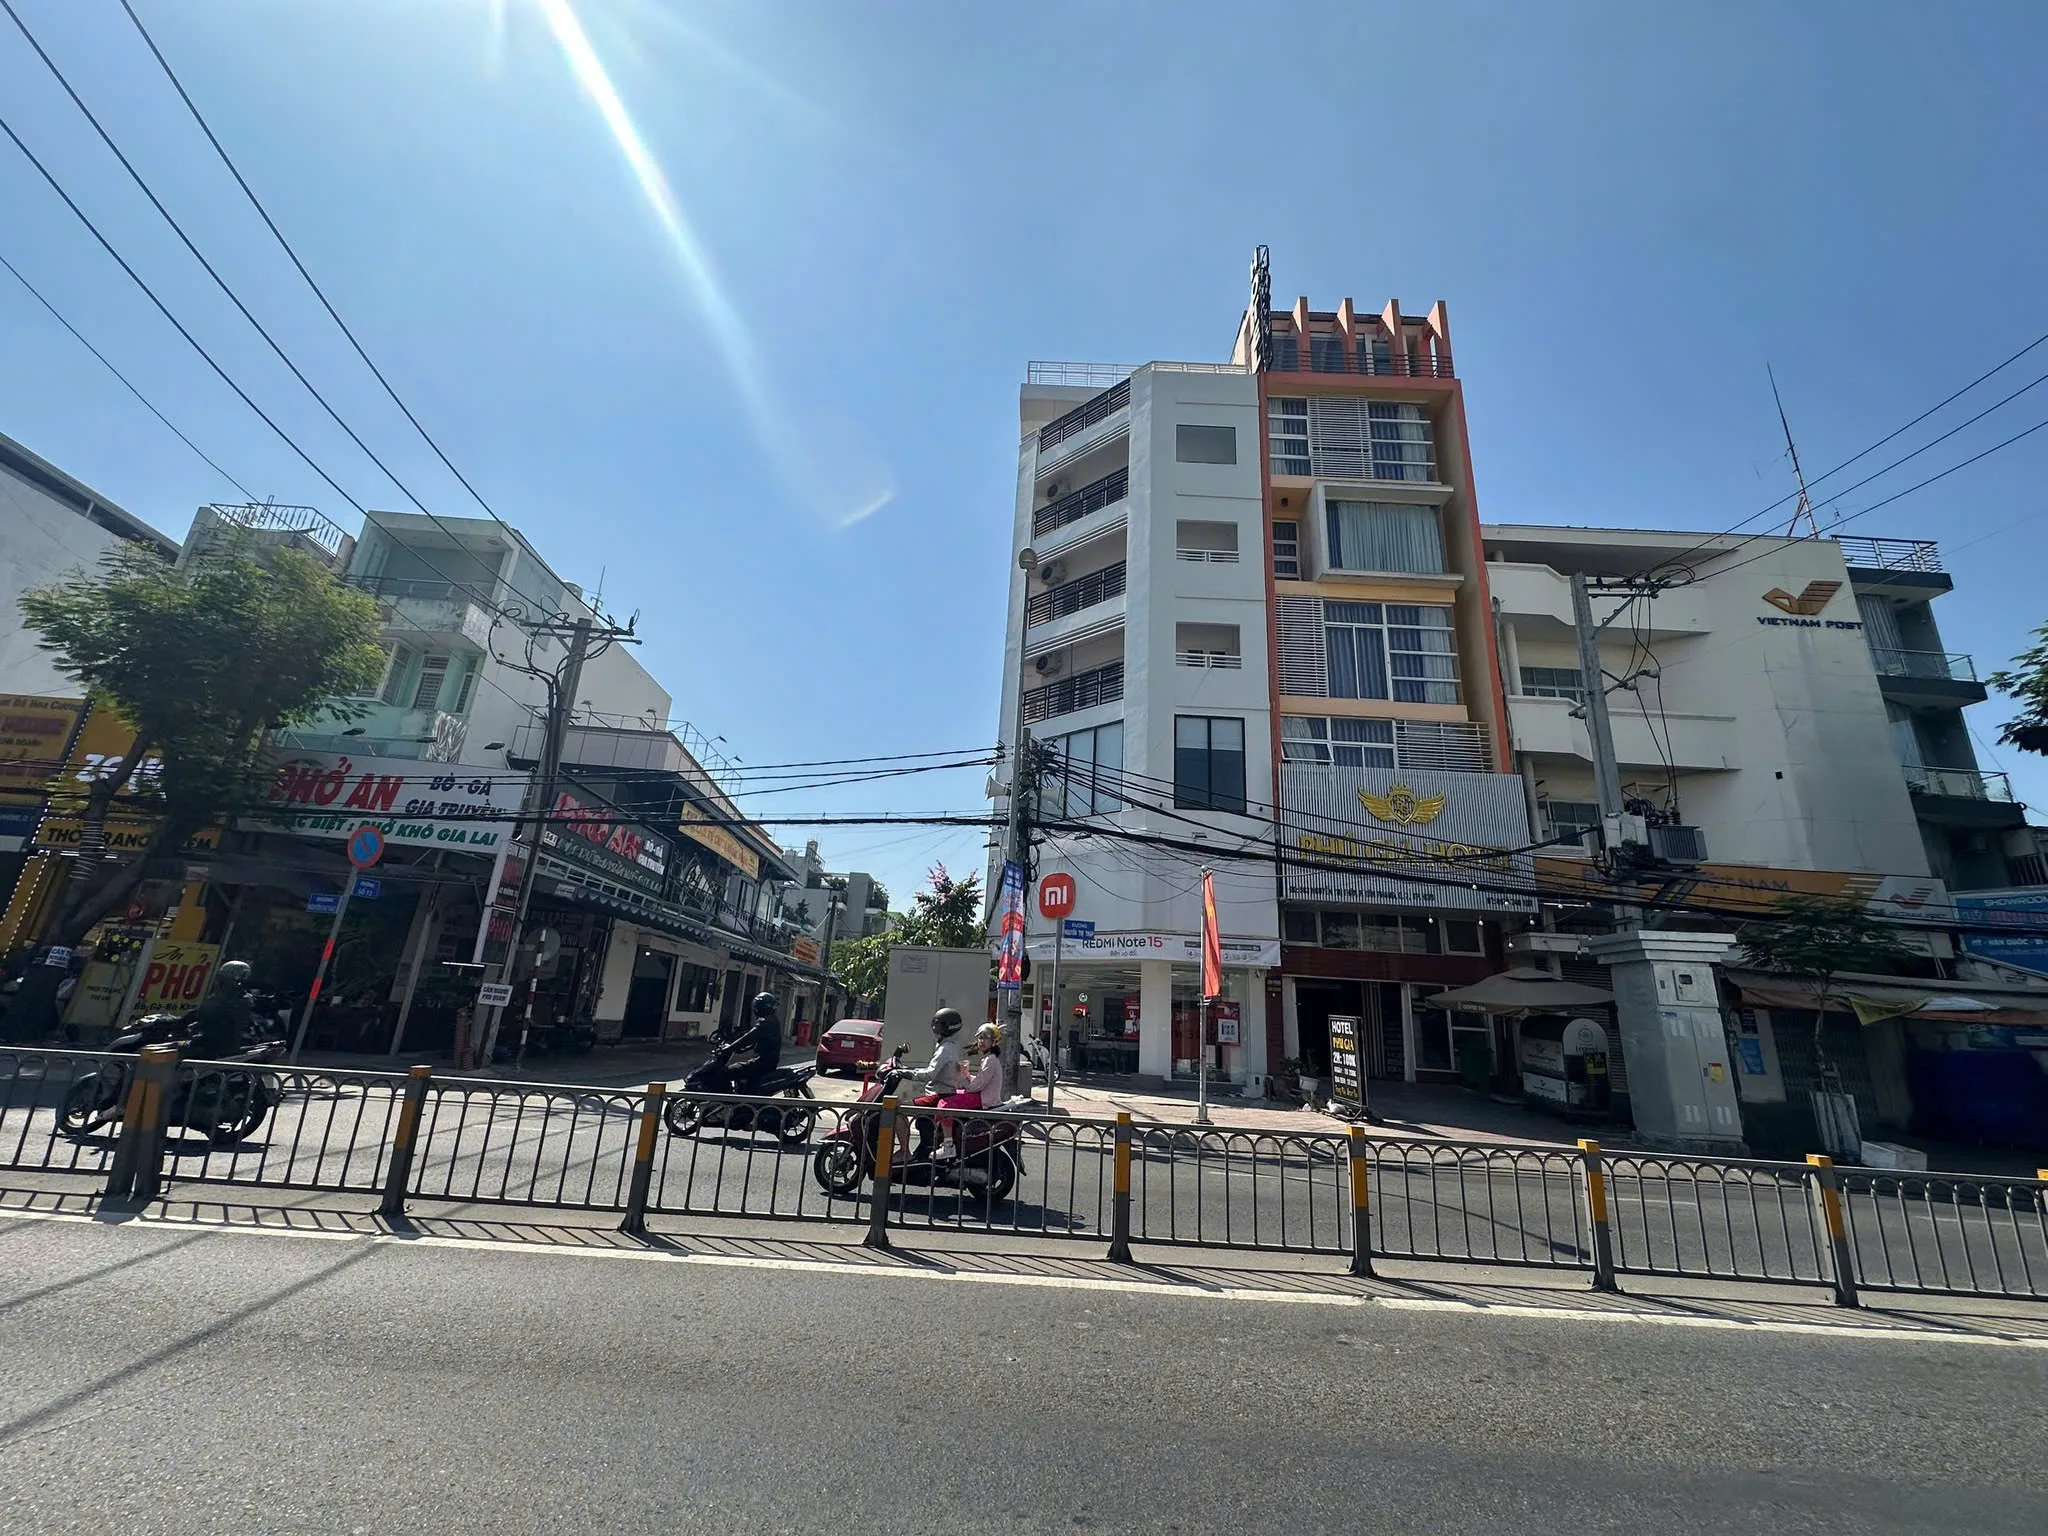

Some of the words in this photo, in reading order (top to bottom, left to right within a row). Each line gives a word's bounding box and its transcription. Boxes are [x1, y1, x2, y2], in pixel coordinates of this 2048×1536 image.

[1757, 616, 1821, 628] VIETNAM
[1826, 620, 1863, 631] POST
[345, 772, 405, 812] AN
[405, 799, 436, 815] GIA
[396, 822, 437, 841] KHÔ
[437, 829, 466, 845] GIA
[468, 831, 499, 847] LAI
[545, 832, 558, 844] 561
[1082, 938, 1115, 949] REDMI
[1117, 936, 1147, 948] Note
[1147, 936, 1163, 948] 15
[137, 953, 212, 1001] PHỞ
[1331, 1021, 1353, 1035] HOTEL
